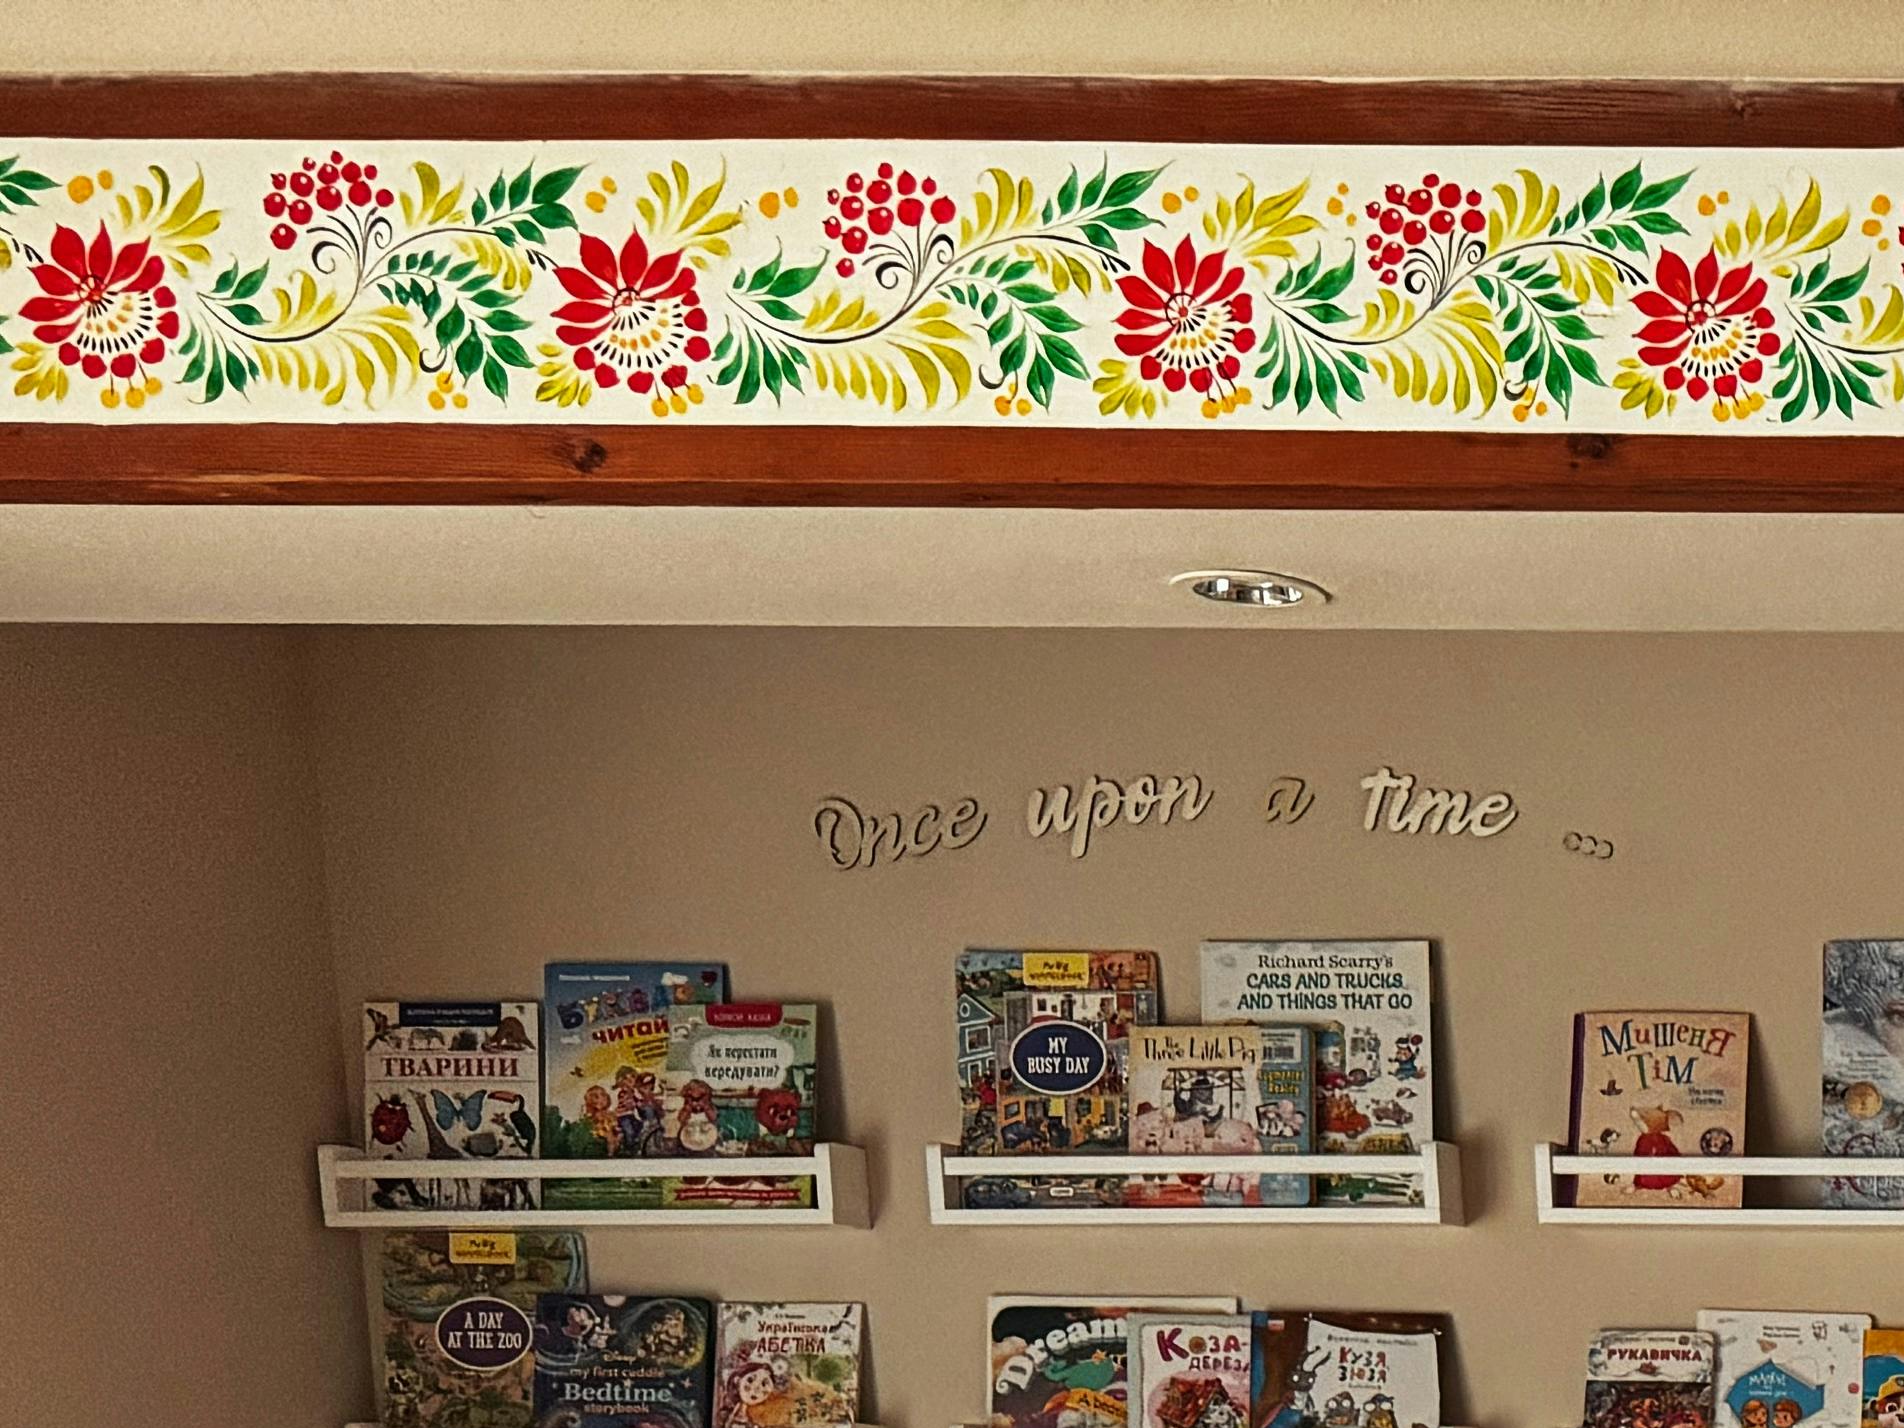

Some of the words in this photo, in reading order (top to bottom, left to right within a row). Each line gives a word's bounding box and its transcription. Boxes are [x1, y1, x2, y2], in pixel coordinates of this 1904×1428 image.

[815, 796, 988, 870] Once
[1027, 764, 1217, 858] upon
[1264, 773, 1316, 825] a
[1360, 764, 1520, 838] time
[1257, 954, 1325, 970] Richard
[1327, 954, 1394, 971] Scarry's
[1246, 971, 1294, 990] CARS
[1297, 972, 1336, 990] AND
[1338, 972, 1404, 989] TRUCKS
[1237, 993, 1274, 1010] AND
[1278, 992, 1338, 1010] THINGS
[1341, 992, 1384, 1010] THAT
[1387, 993, 1413, 1010] GO
[1048, 1036, 1068, 1056] MY
[381, 1054, 520, 1080] ТВАРИНИ
[1027, 1056, 1061, 1074] BUSY
[1065, 1055, 1090, 1075] DAY
[464, 1312, 474, 1329] A
[477, 1312, 504, 1330] DAY
[447, 1331, 468, 1350] AT
[469, 1331, 494, 1349] THE
[497, 1331, 523, 1350] ZOO
[1606, 1347, 1703, 1362] РУКАВИЧКА
[563, 1381, 673, 1402] Bedtime
